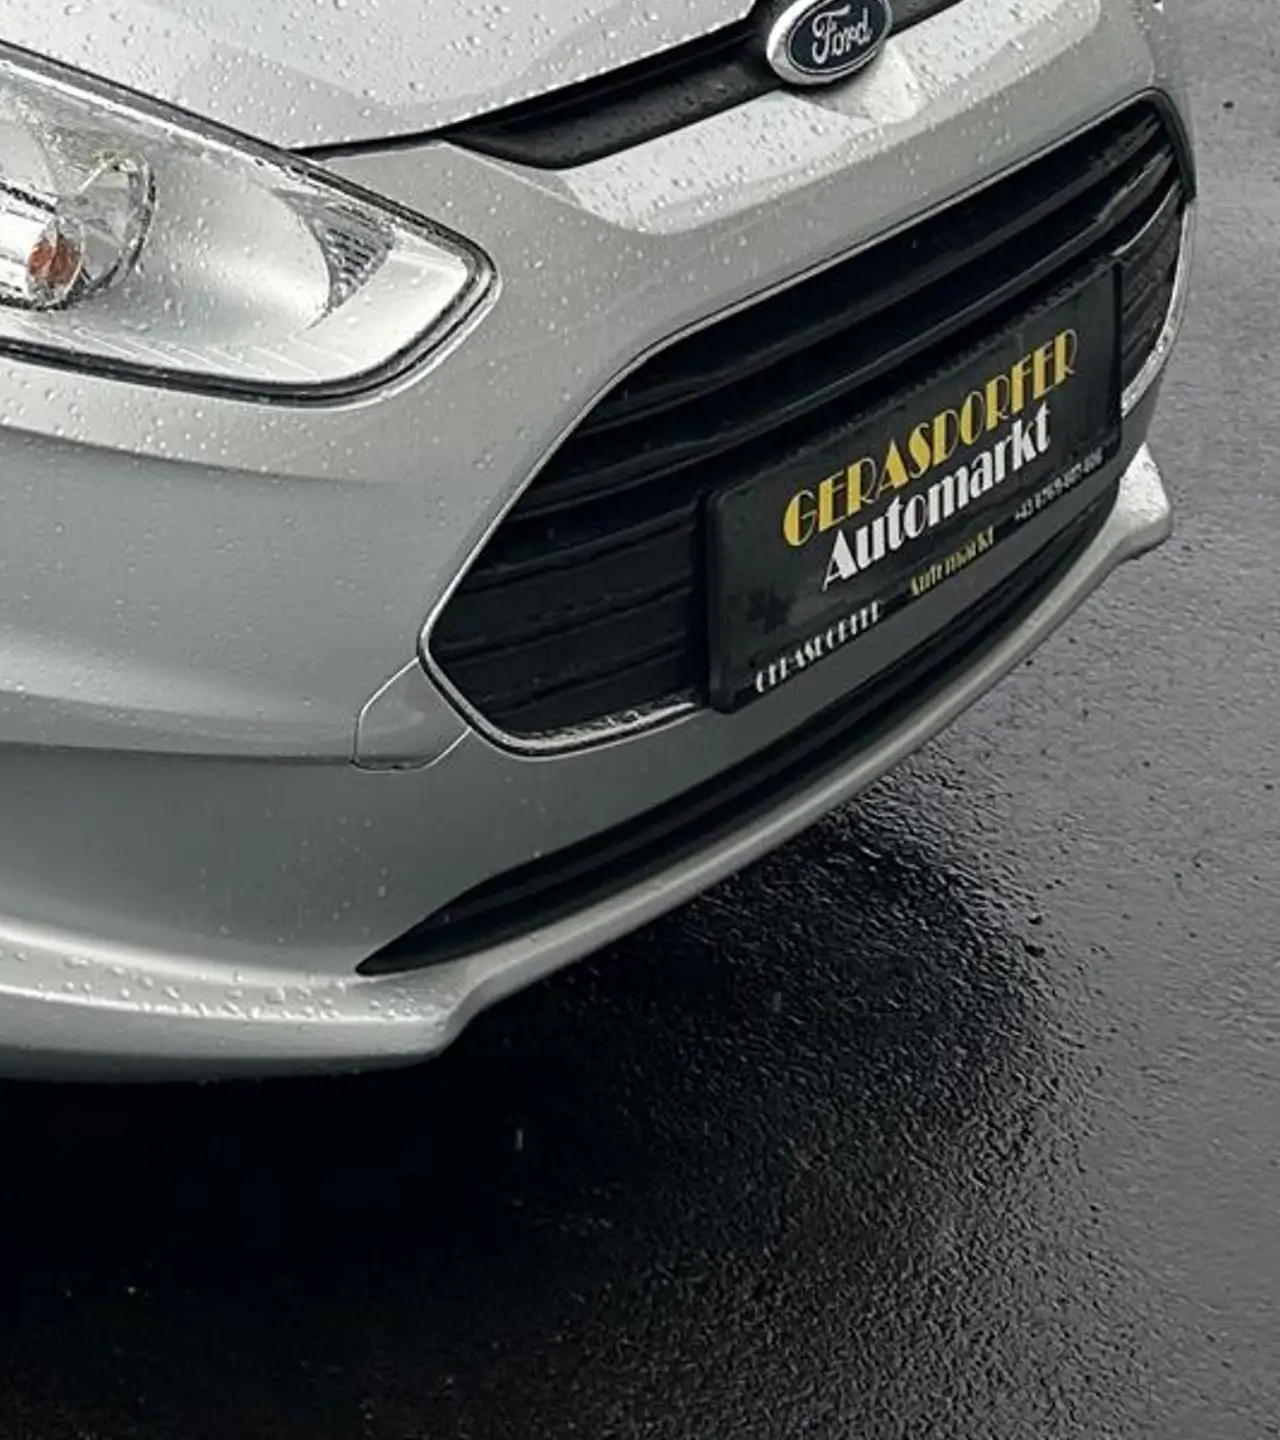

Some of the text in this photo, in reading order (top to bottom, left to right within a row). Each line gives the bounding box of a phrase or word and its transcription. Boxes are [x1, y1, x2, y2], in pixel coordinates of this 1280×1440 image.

[811, 4, 873, 64] Ford
[783, 328, 1078, 547] GERASDORFER
[822, 401, 1051, 592] Automarkt
